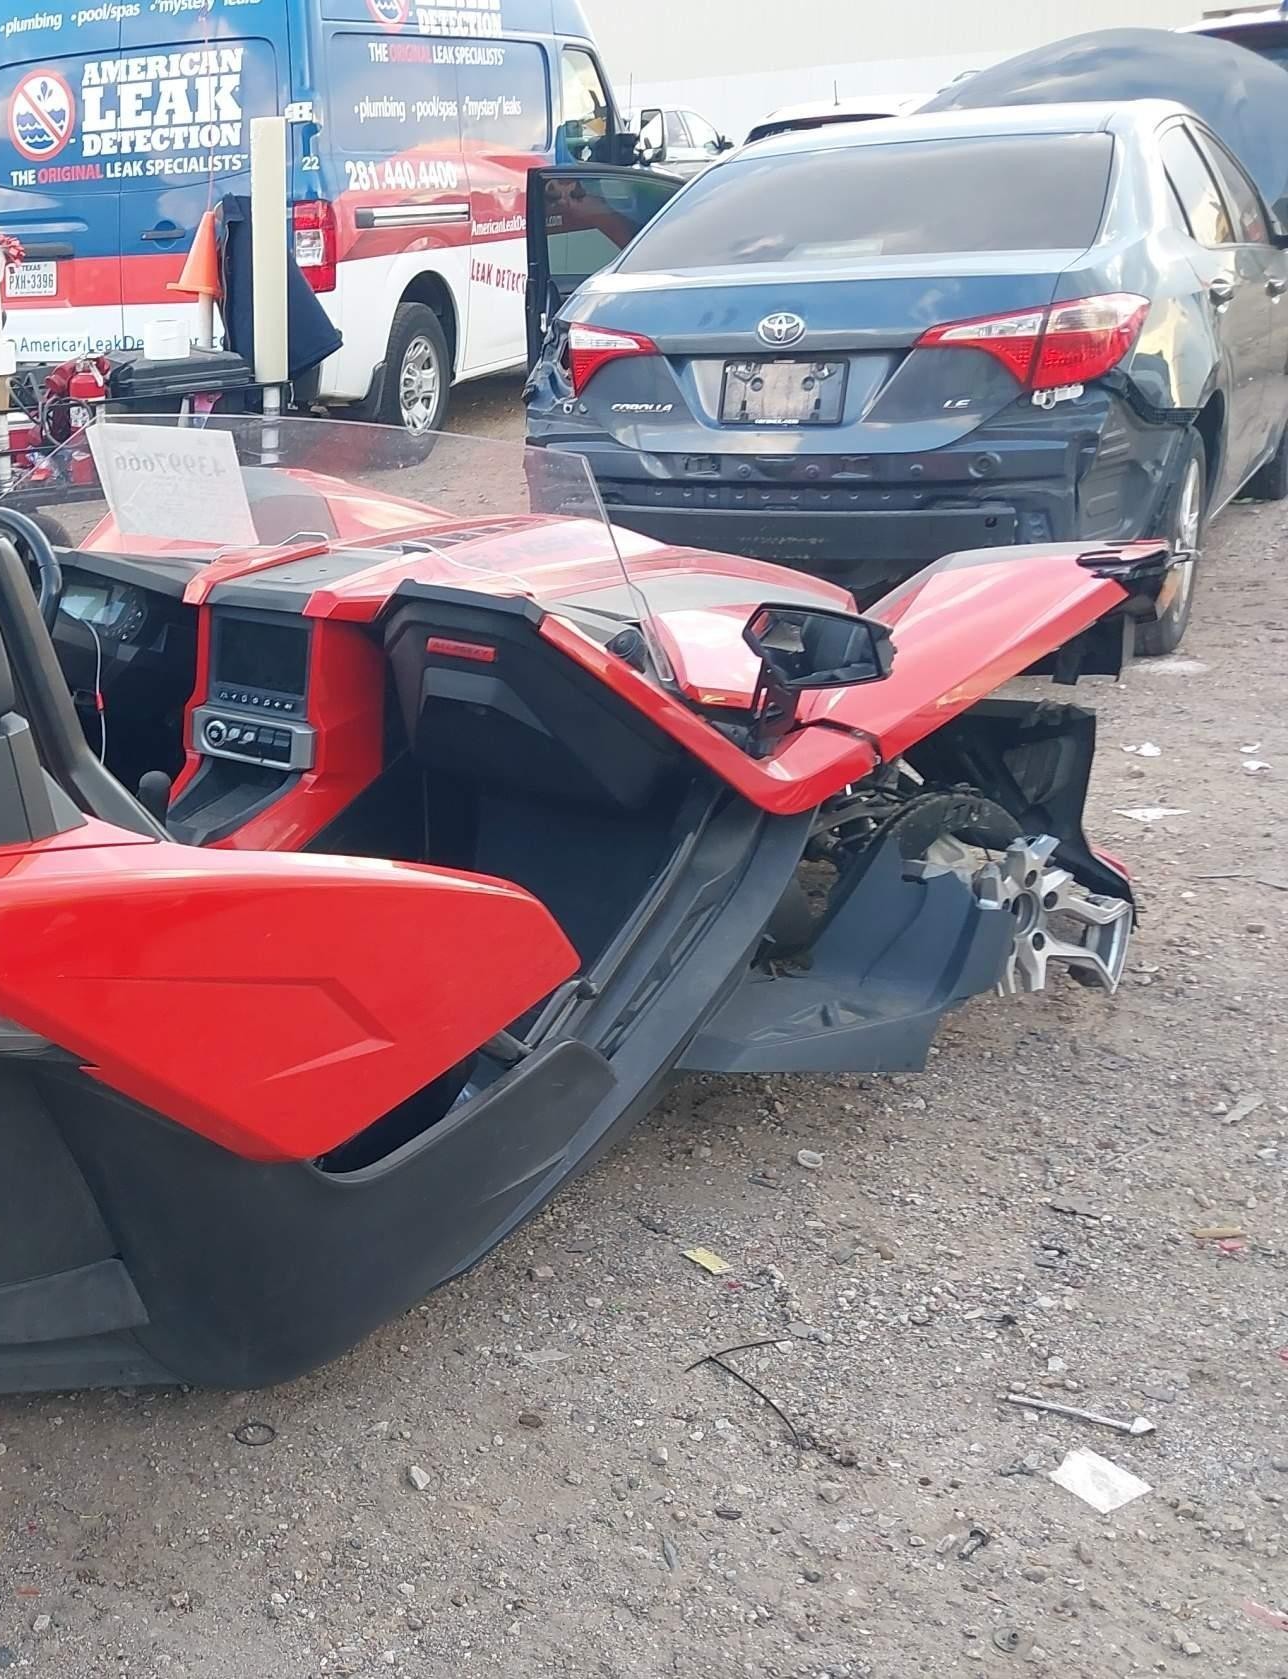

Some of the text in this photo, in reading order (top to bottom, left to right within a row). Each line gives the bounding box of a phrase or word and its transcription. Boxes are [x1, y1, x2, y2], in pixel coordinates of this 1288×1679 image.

[5, 12, 62, 38] plumbing
[77, 2, 141, 27] pool/spas
[416, 9, 503, 38] DETECTION
[82, 48, 244, 86] AMERICAN
[368, 42, 389, 63] THE
[432, 46, 455, 64] LEAK
[82, 74, 242, 133] LEAK
[360, 96, 406, 123] plumbing
[416, 98, 458, 122] pool/spas
[502, 96, 522, 115] leaks
[82, 122, 242, 158] DETECTION
[10, 170, 36, 187] THE
[37, 163, 104, 184] ORIGINAL
[106, 159, 144, 178] LEAK
[302, 156, 320, 171] 22
[344, 161, 458, 191] 281.440.4400
[21, 264, 41, 272] TEXAS
[471, 258, 494, 286] LEAK
[610, 403, 673, 413] COROLLA
[942, 399, 971, 409] LE
